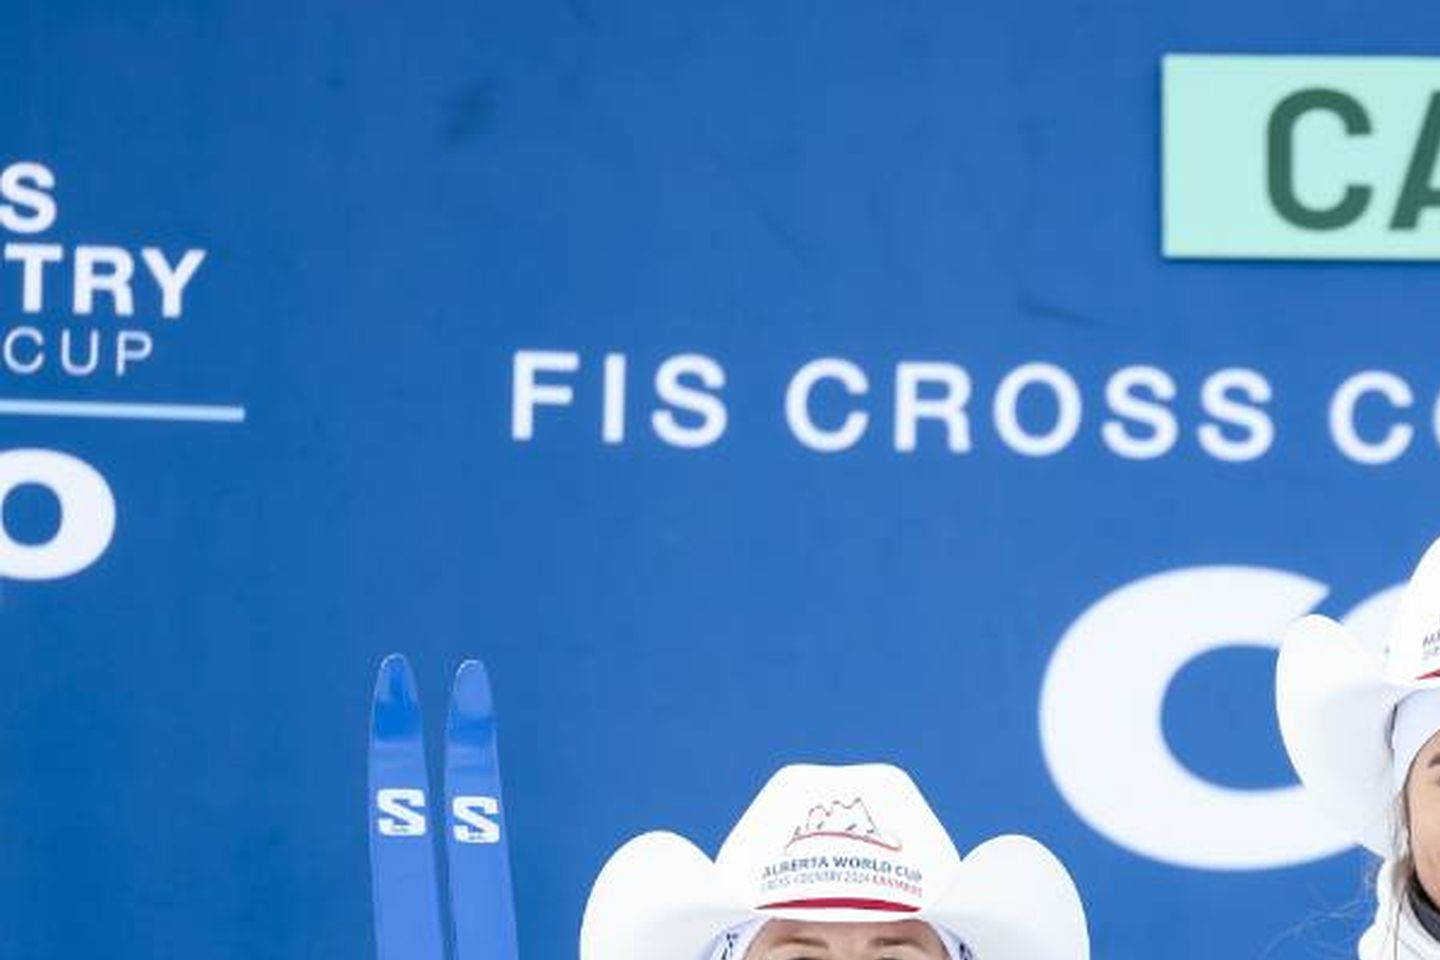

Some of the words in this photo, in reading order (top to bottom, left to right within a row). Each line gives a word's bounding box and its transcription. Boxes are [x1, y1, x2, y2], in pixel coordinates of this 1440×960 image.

[4, 243, 206, 318] TRY
[3, 327, 153, 376] CUP
[511, 350, 729, 448] FIS
[785, 358, 1275, 462] CROSS
[377, 788, 427, 837] S
[452, 795, 501, 844] S
[761, 857, 830, 881] ALBERTA
[832, 856, 893, 874] WORLD
[894, 864, 924, 883] CUP
